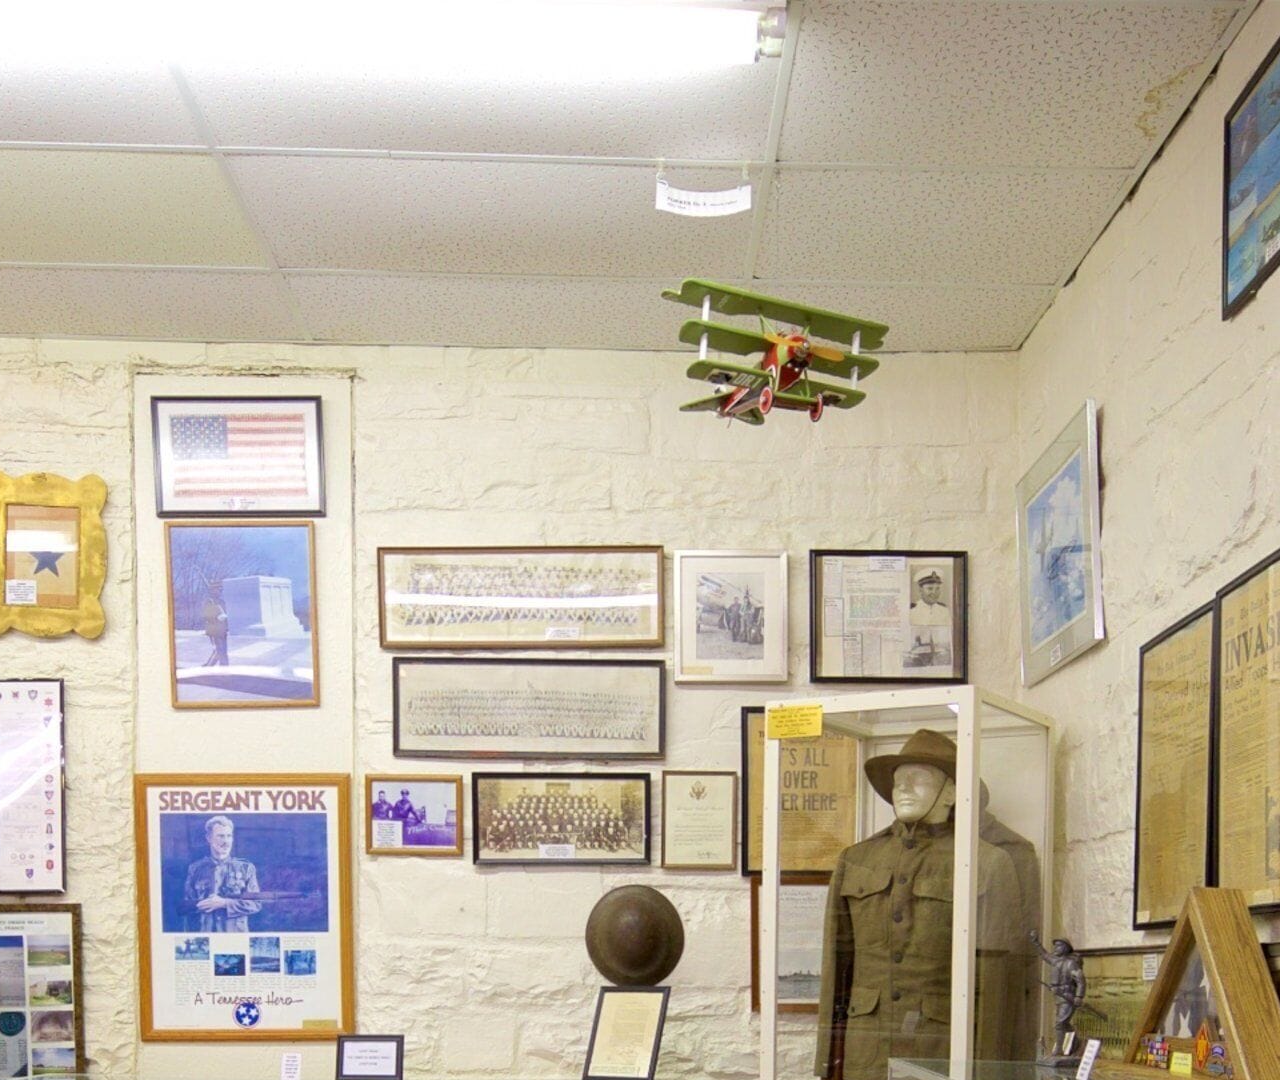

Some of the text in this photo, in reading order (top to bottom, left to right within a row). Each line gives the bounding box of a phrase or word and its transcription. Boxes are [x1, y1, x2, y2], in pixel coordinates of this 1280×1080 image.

[803, 747, 830, 767] ALL
[783, 770, 818, 789] OVER
[158, 790, 327, 812] SERGEANT YORK
[781, 794, 837, 811] ER HERE
[194, 991, 300, 1007] A Tennessee Hero
